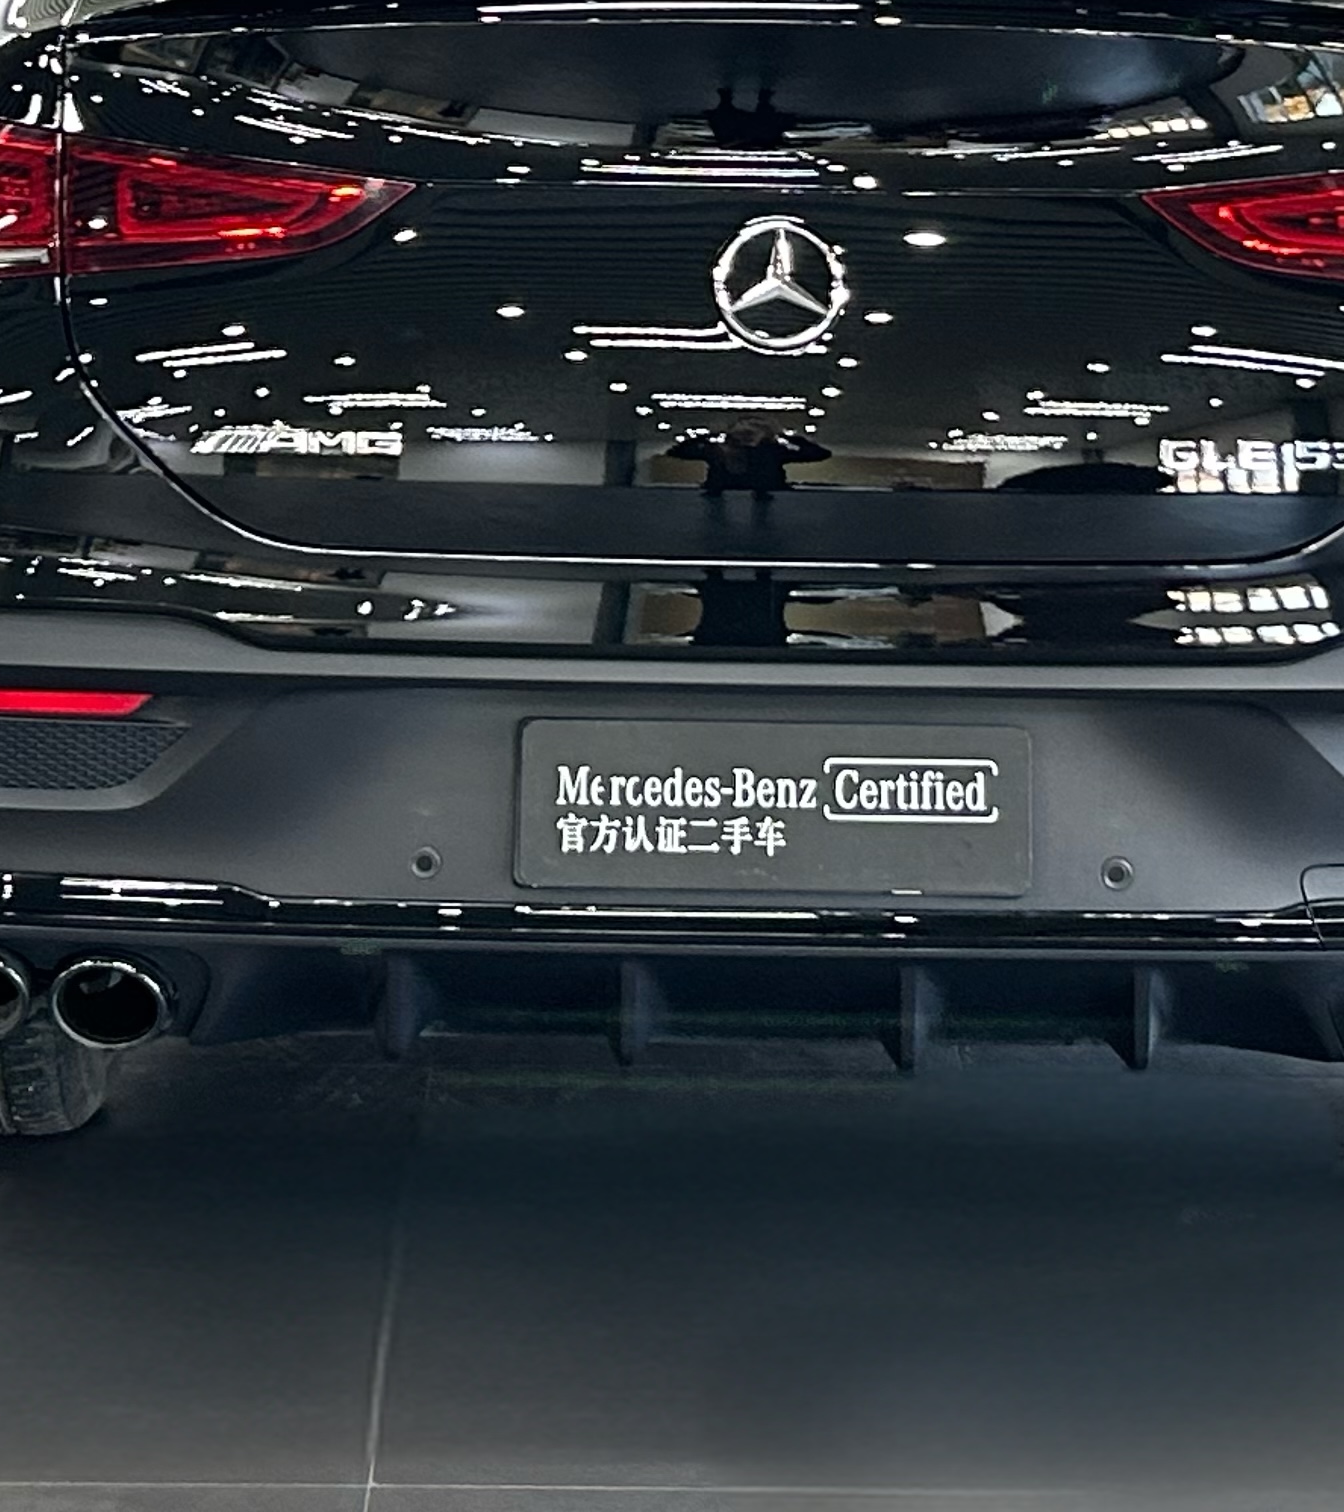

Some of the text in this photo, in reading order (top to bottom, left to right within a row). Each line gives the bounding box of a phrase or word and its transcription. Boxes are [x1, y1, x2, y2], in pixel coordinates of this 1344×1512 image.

[258, 430, 403, 456] AMG
[556, 766, 987, 811] Mercedes-Benz Certified
[557, 812, 787, 857] 官方认证二手车
